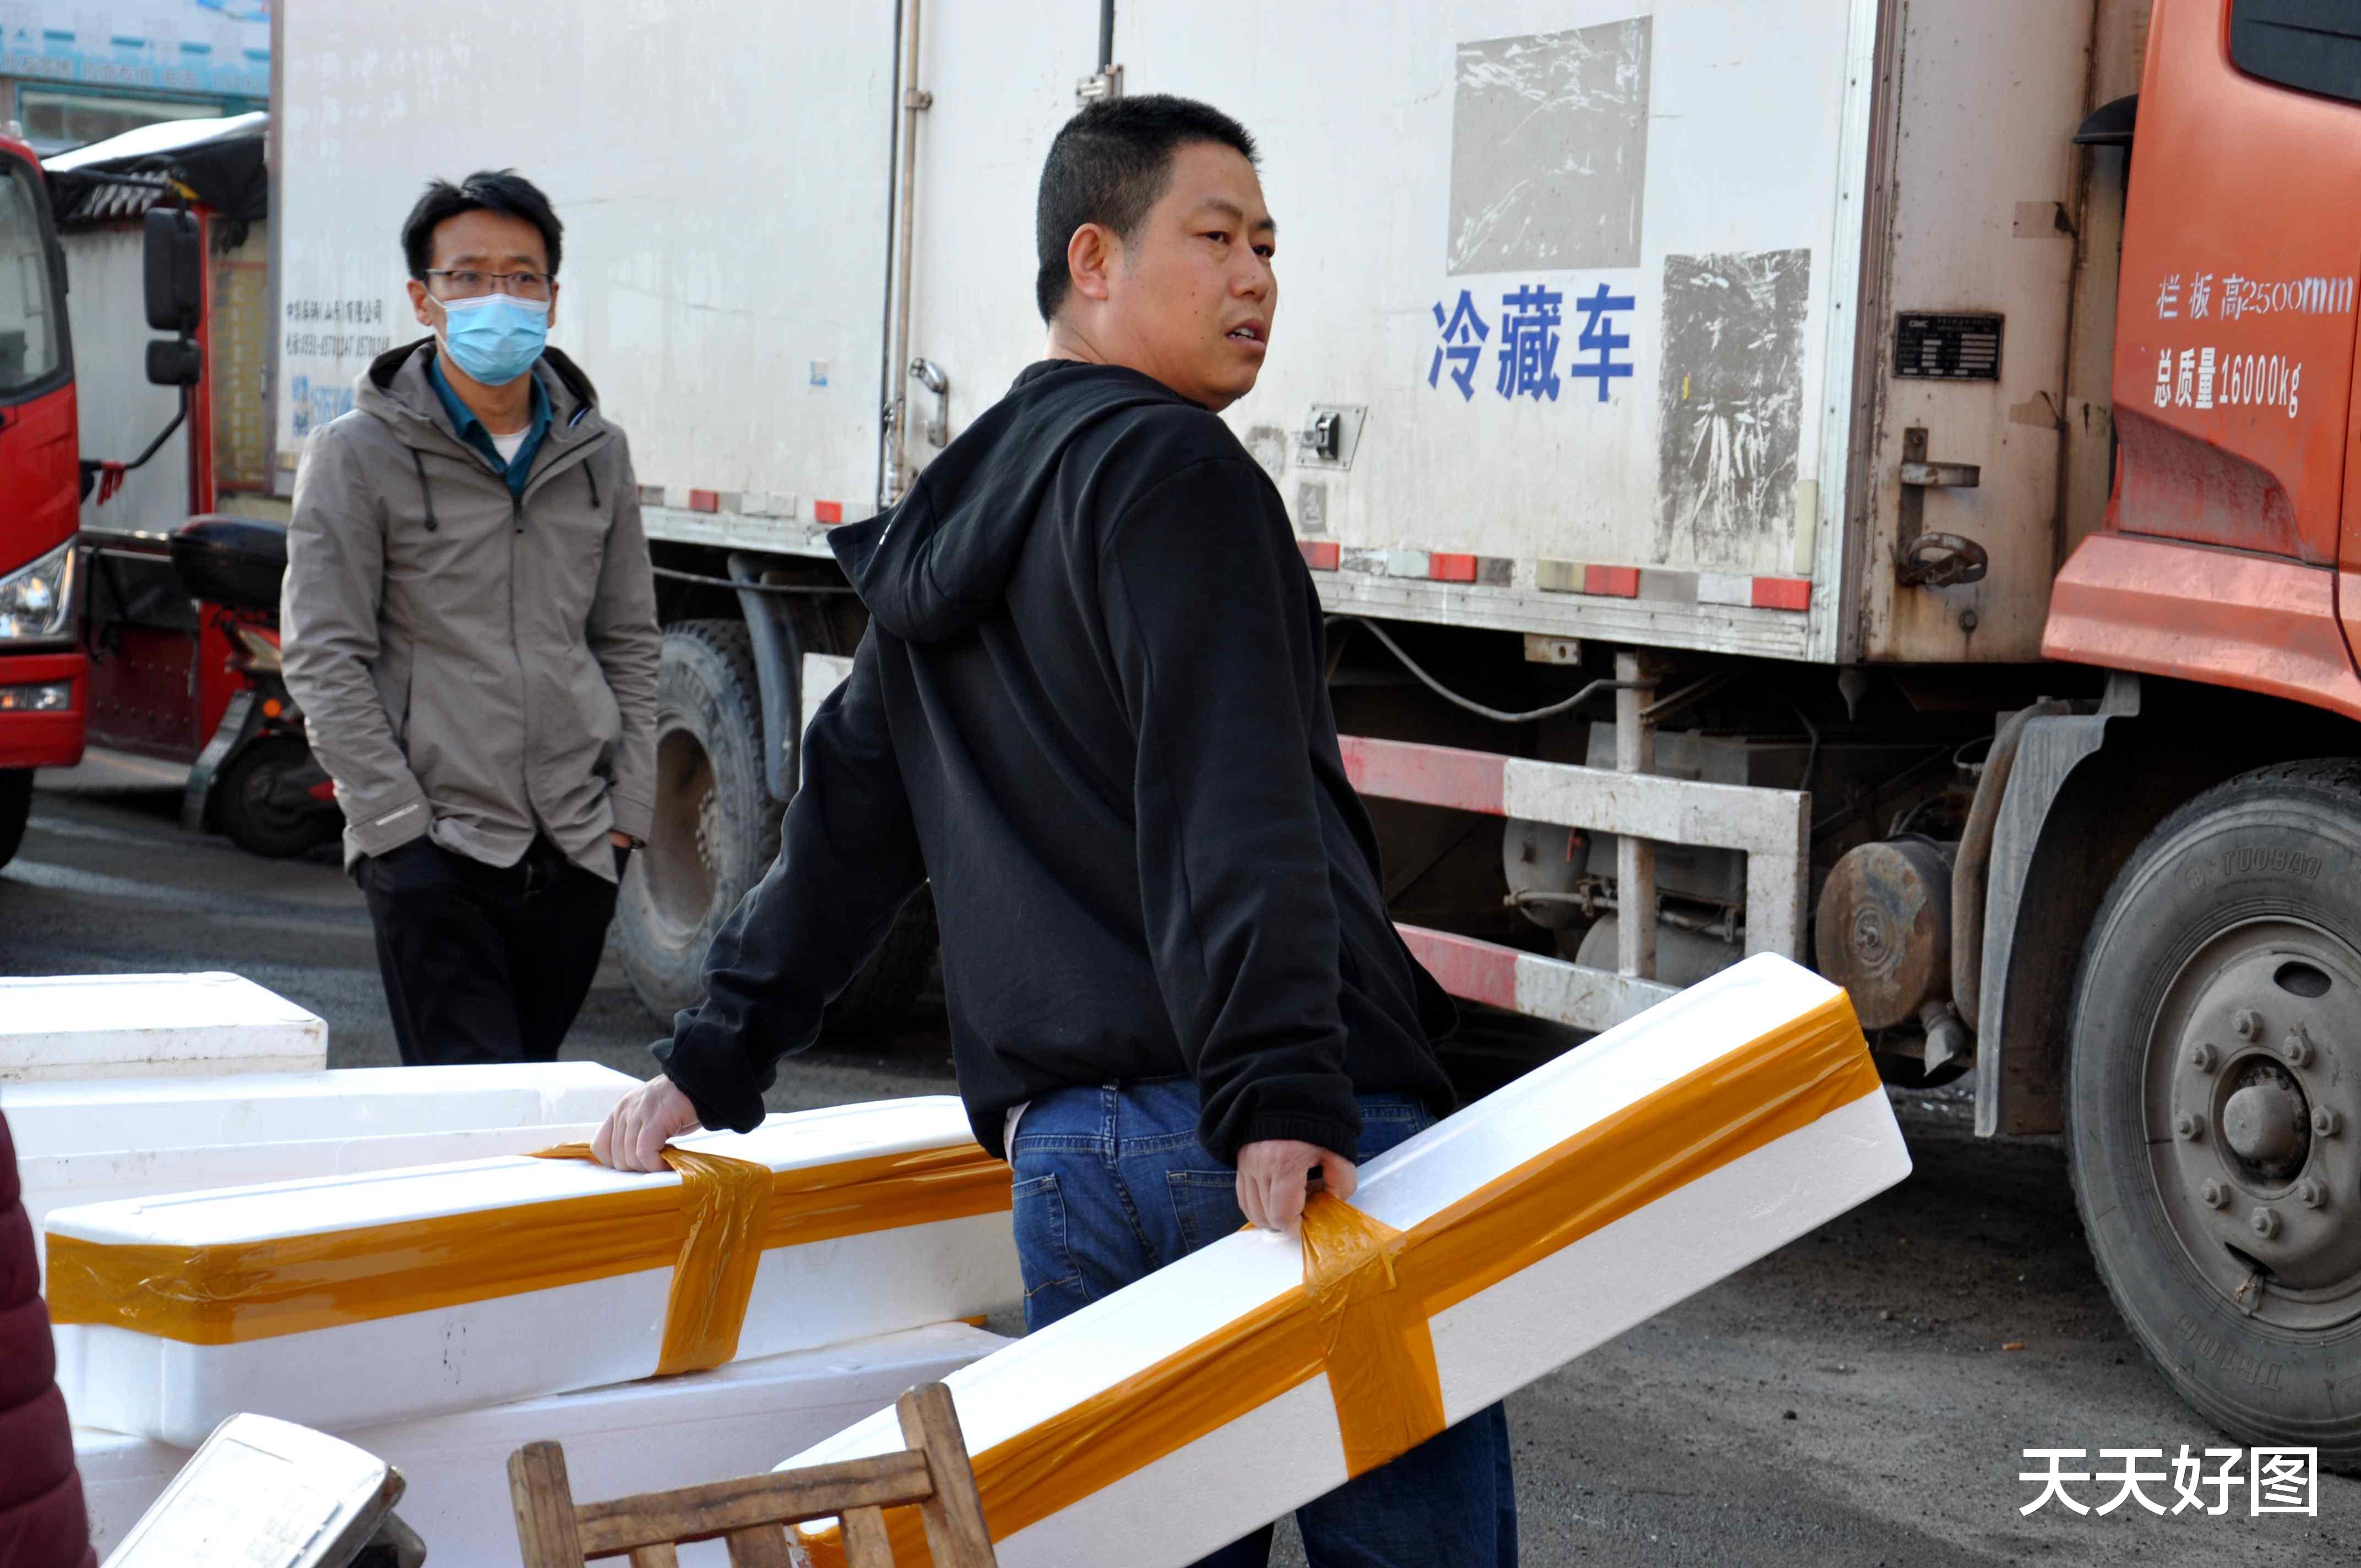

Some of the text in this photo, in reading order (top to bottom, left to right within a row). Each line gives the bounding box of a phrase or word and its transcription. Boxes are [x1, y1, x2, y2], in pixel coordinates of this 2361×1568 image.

[1428, 283, 1635, 402] 冷藏车
[2153, 347, 2303, 418] 总质量16000kg
